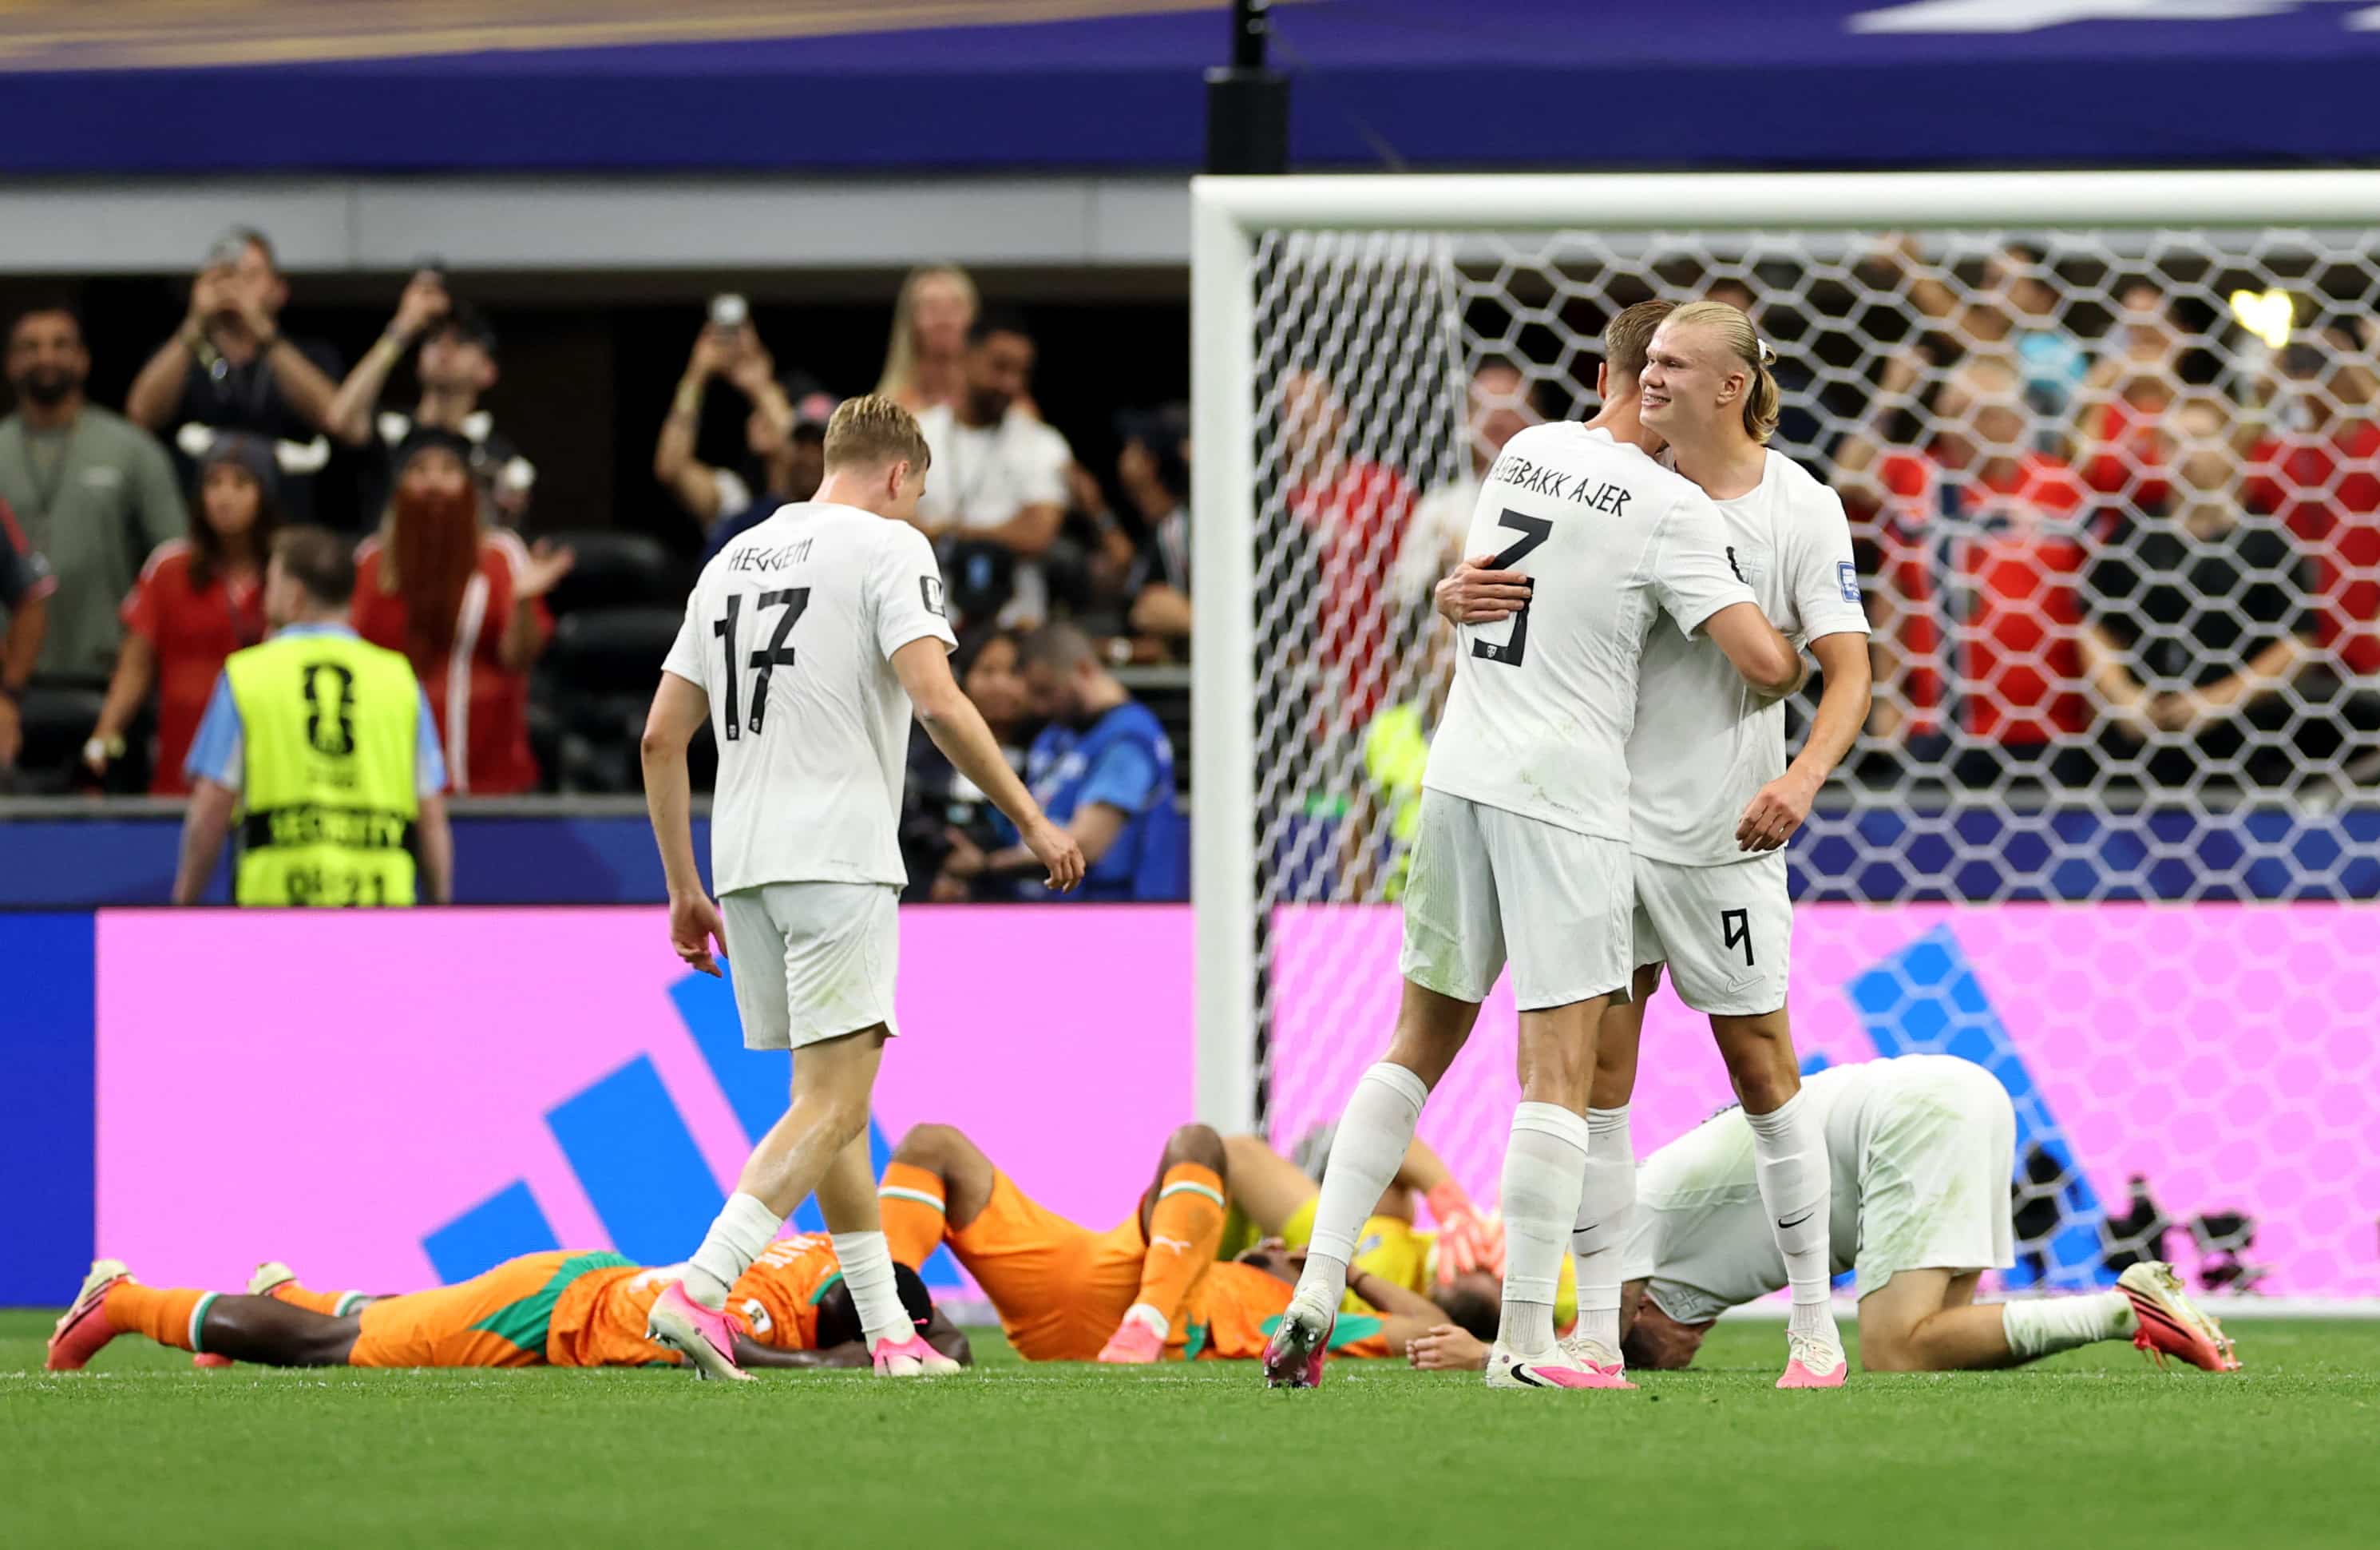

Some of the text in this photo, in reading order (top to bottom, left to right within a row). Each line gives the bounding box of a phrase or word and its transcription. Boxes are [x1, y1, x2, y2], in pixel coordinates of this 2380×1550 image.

[1567, 478, 1632, 517] AJER
[727, 537, 814, 572] HEGGEM
[1471, 507, 1554, 668] 3
[714, 587, 811, 741] 17
[1721, 908, 1754, 967] 9
